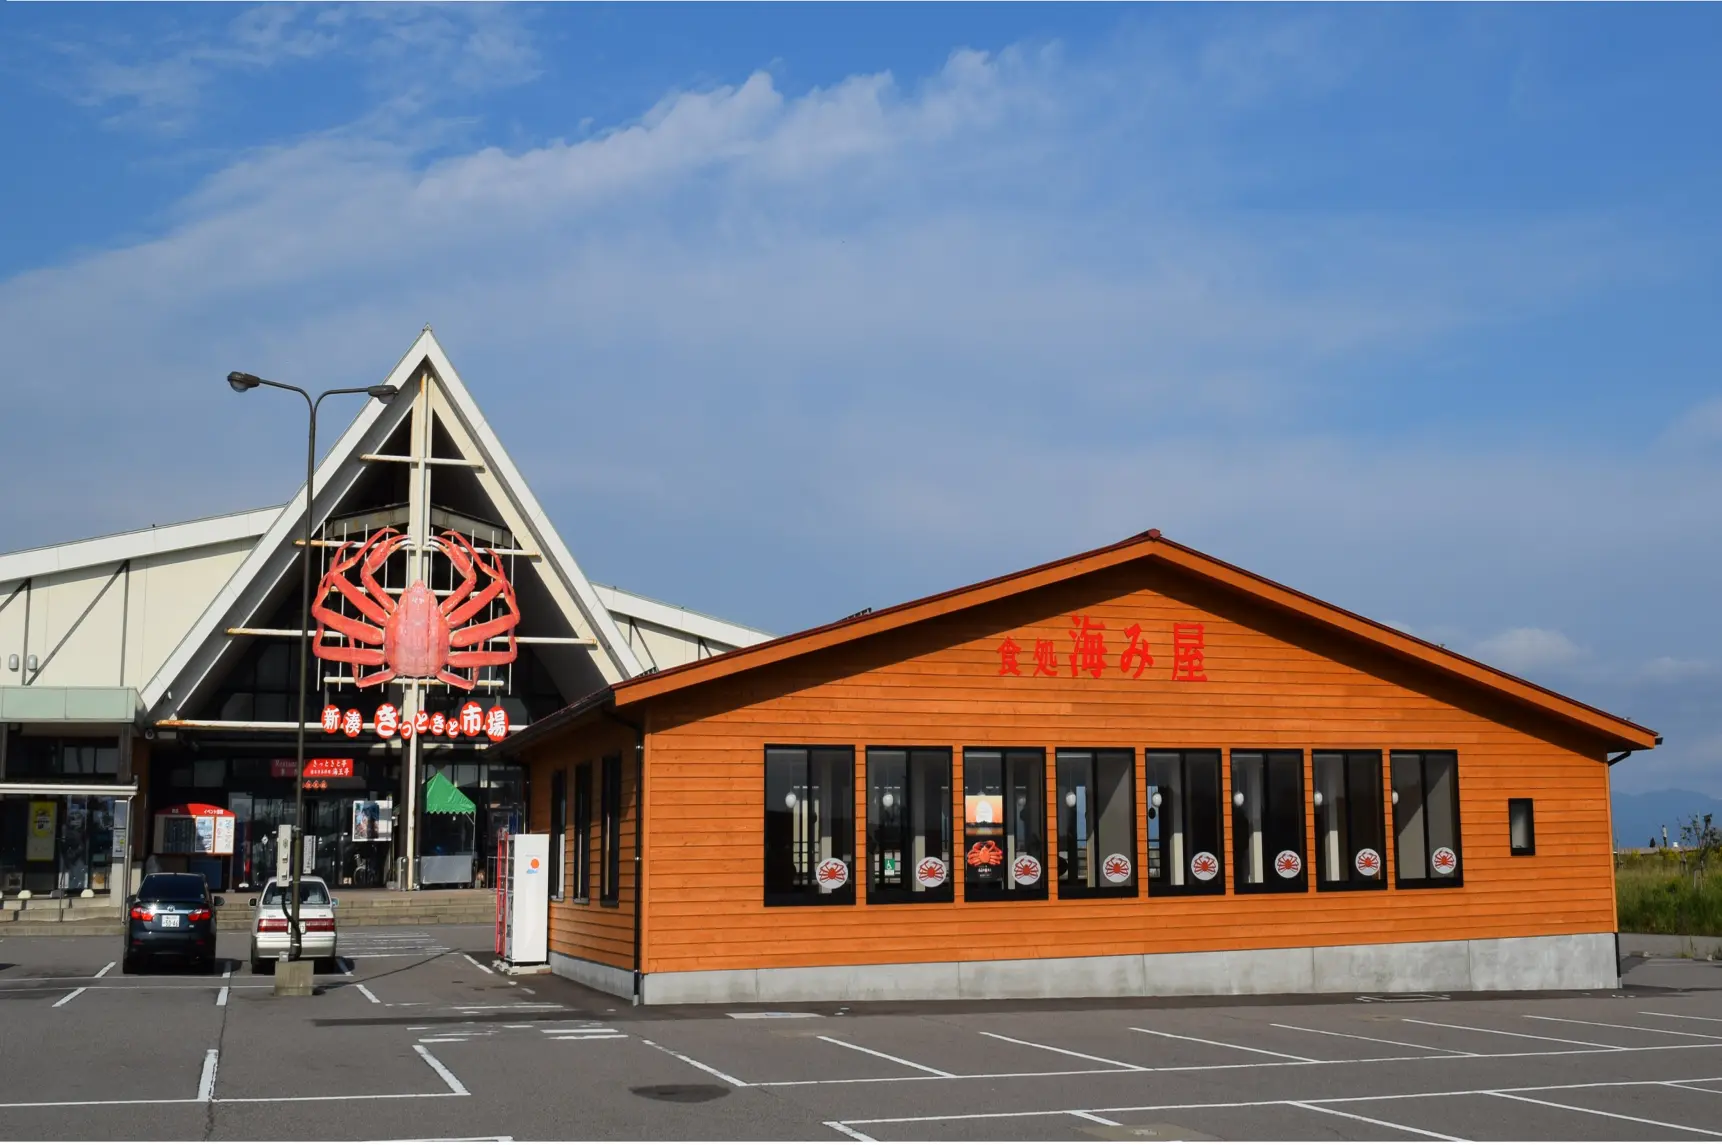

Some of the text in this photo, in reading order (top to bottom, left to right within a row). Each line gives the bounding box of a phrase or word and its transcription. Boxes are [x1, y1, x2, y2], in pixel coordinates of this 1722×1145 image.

[997, 613, 1207, 681] 食処 海み屋
[323, 704, 507, 738] 新湊 きっときと市場
